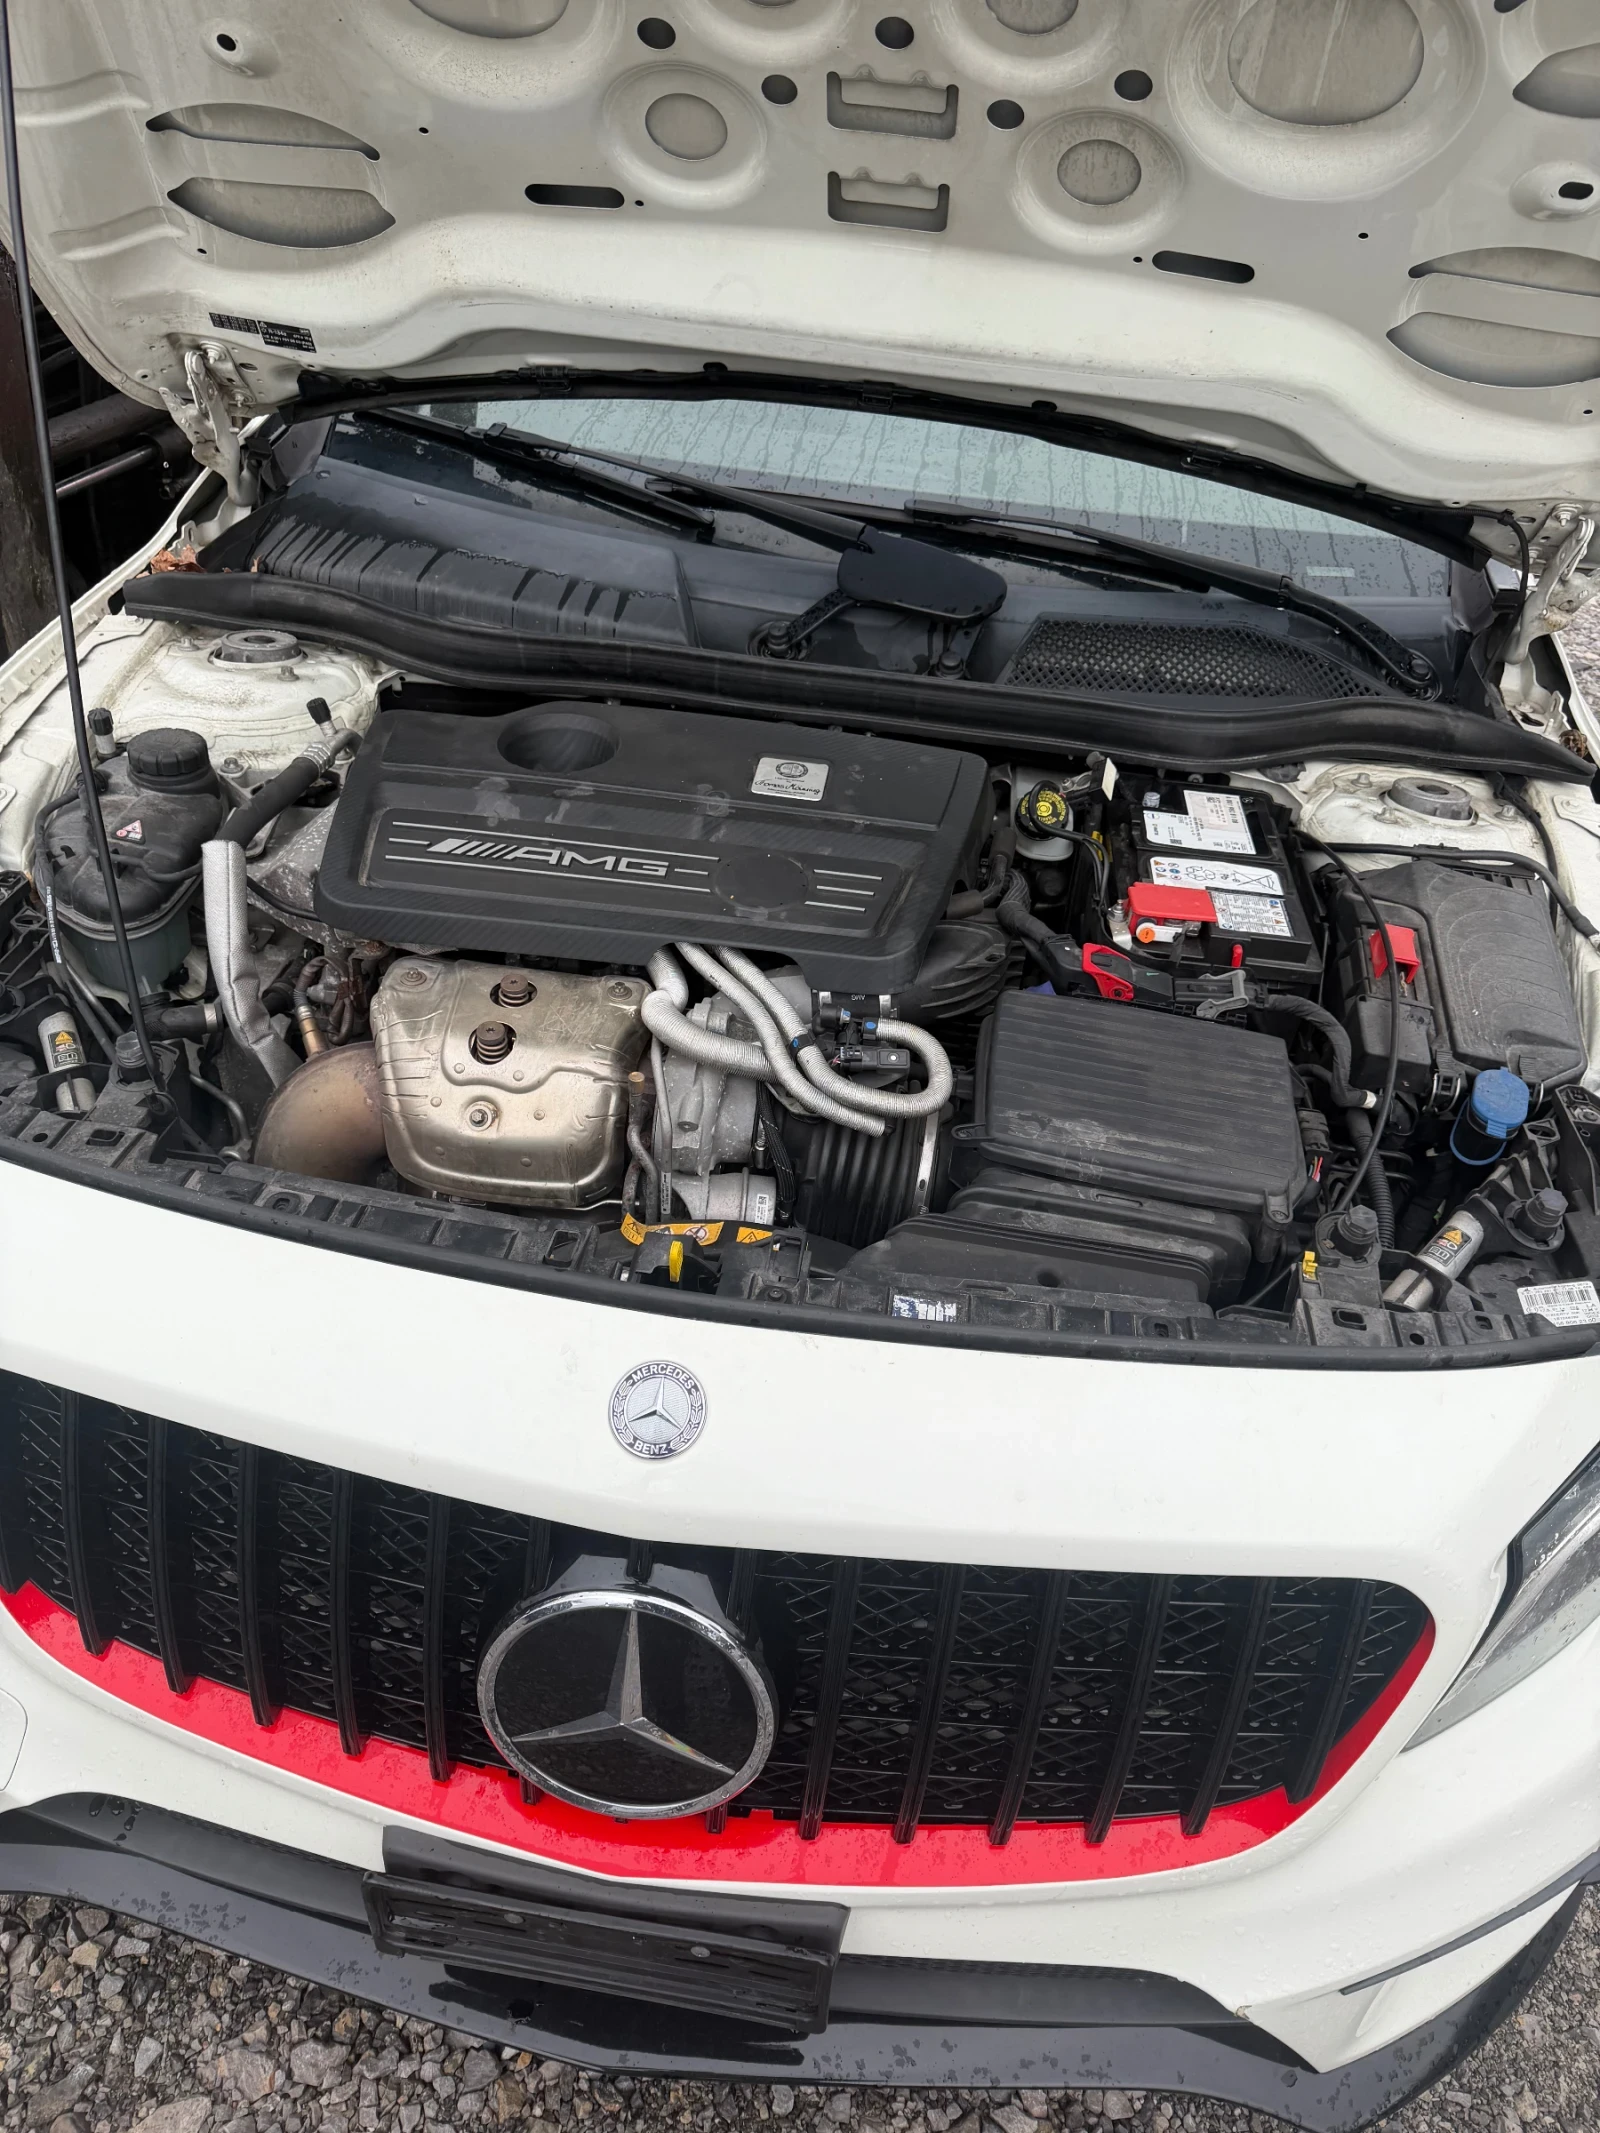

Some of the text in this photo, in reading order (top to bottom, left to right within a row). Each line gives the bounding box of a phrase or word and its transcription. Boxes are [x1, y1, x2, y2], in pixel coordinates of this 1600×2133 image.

[503, 846, 669, 876] AMG
[631, 1364, 695, 1390] MERCEDES
[633, 1440, 669, 1455] BENZ
